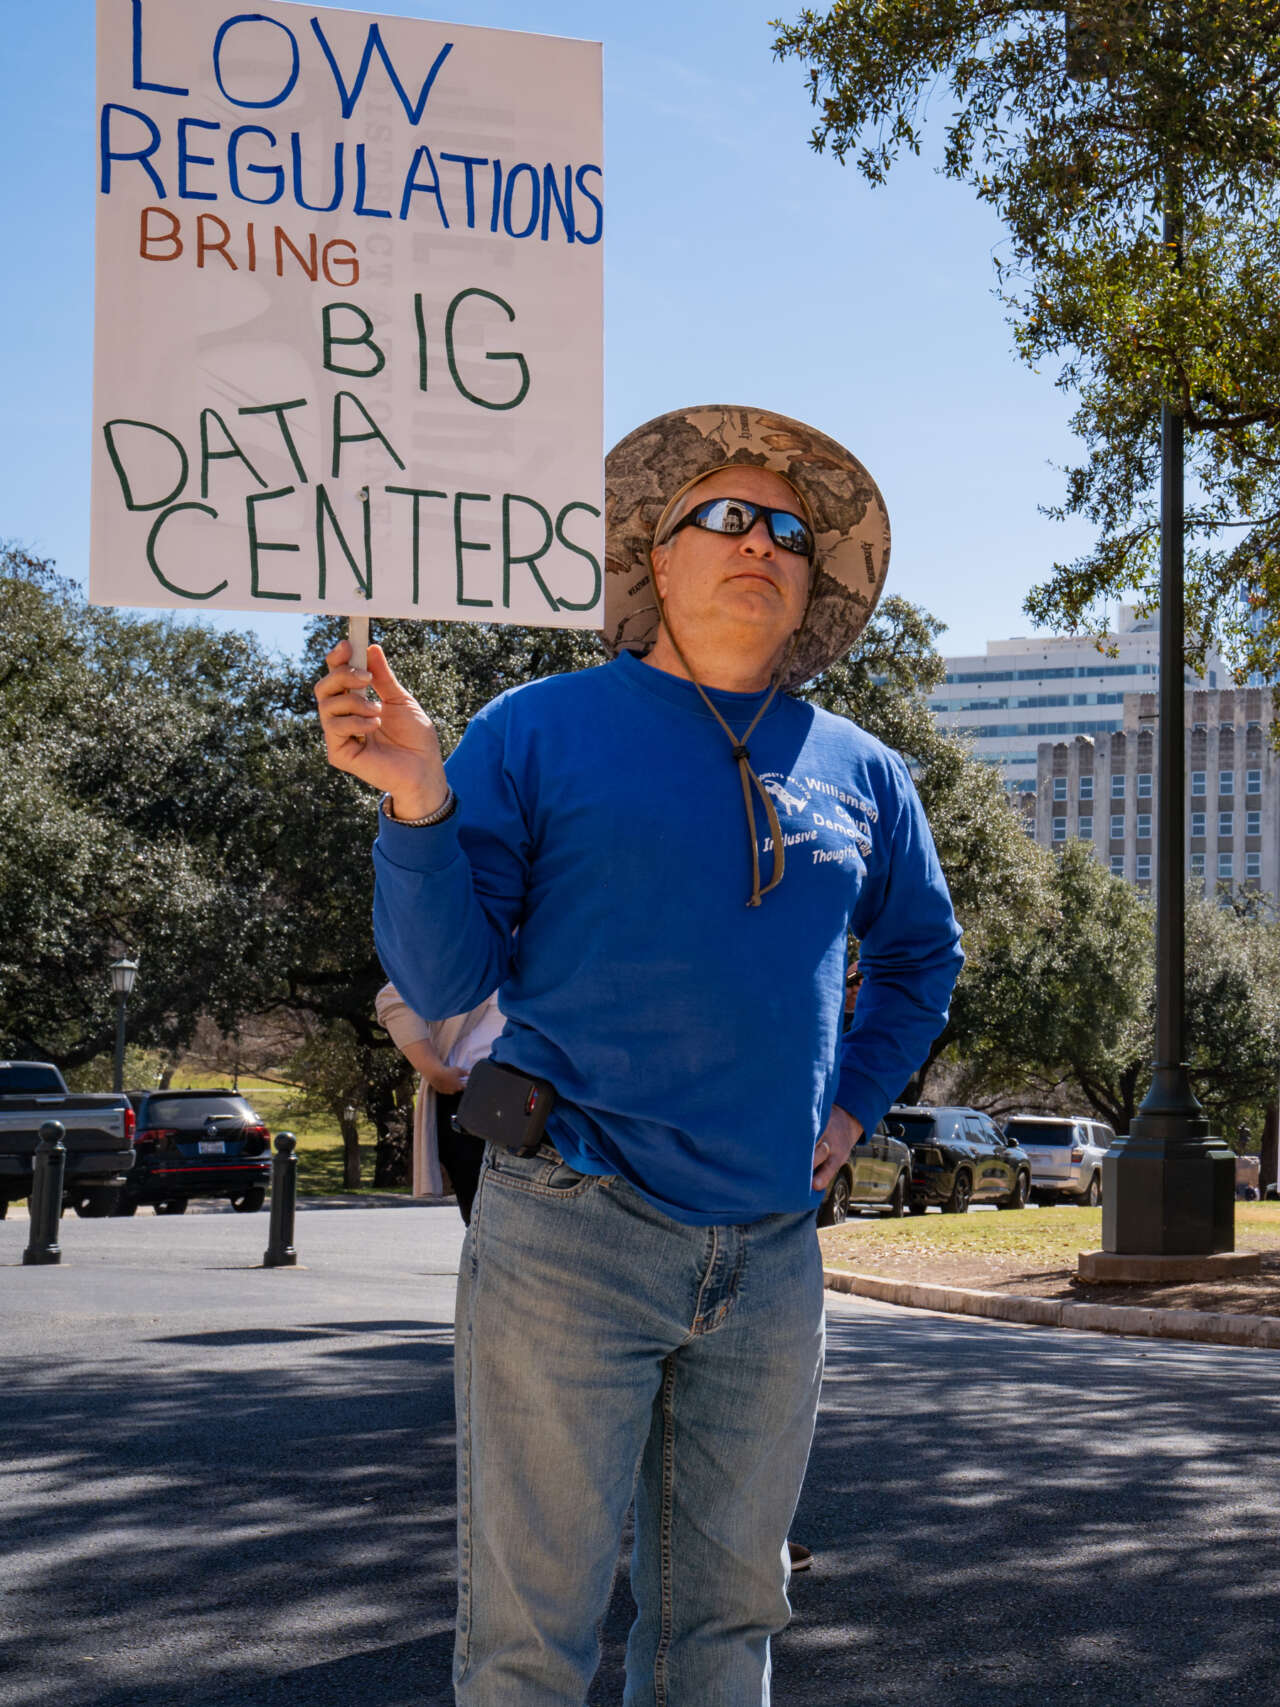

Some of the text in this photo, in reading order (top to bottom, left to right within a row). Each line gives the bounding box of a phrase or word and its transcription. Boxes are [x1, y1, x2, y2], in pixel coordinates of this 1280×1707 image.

[132, 0, 454, 125] LOW
[100, 103, 603, 245] REGULATIONS
[139, 206, 360, 287] BRING
[322, 287, 530, 410] BIG
[104, 391, 405, 511] DATA
[147, 484, 602, 612] CENTERS
[762, 829, 818, 852] Inlusive
[805, 777, 878, 823] Williamson
